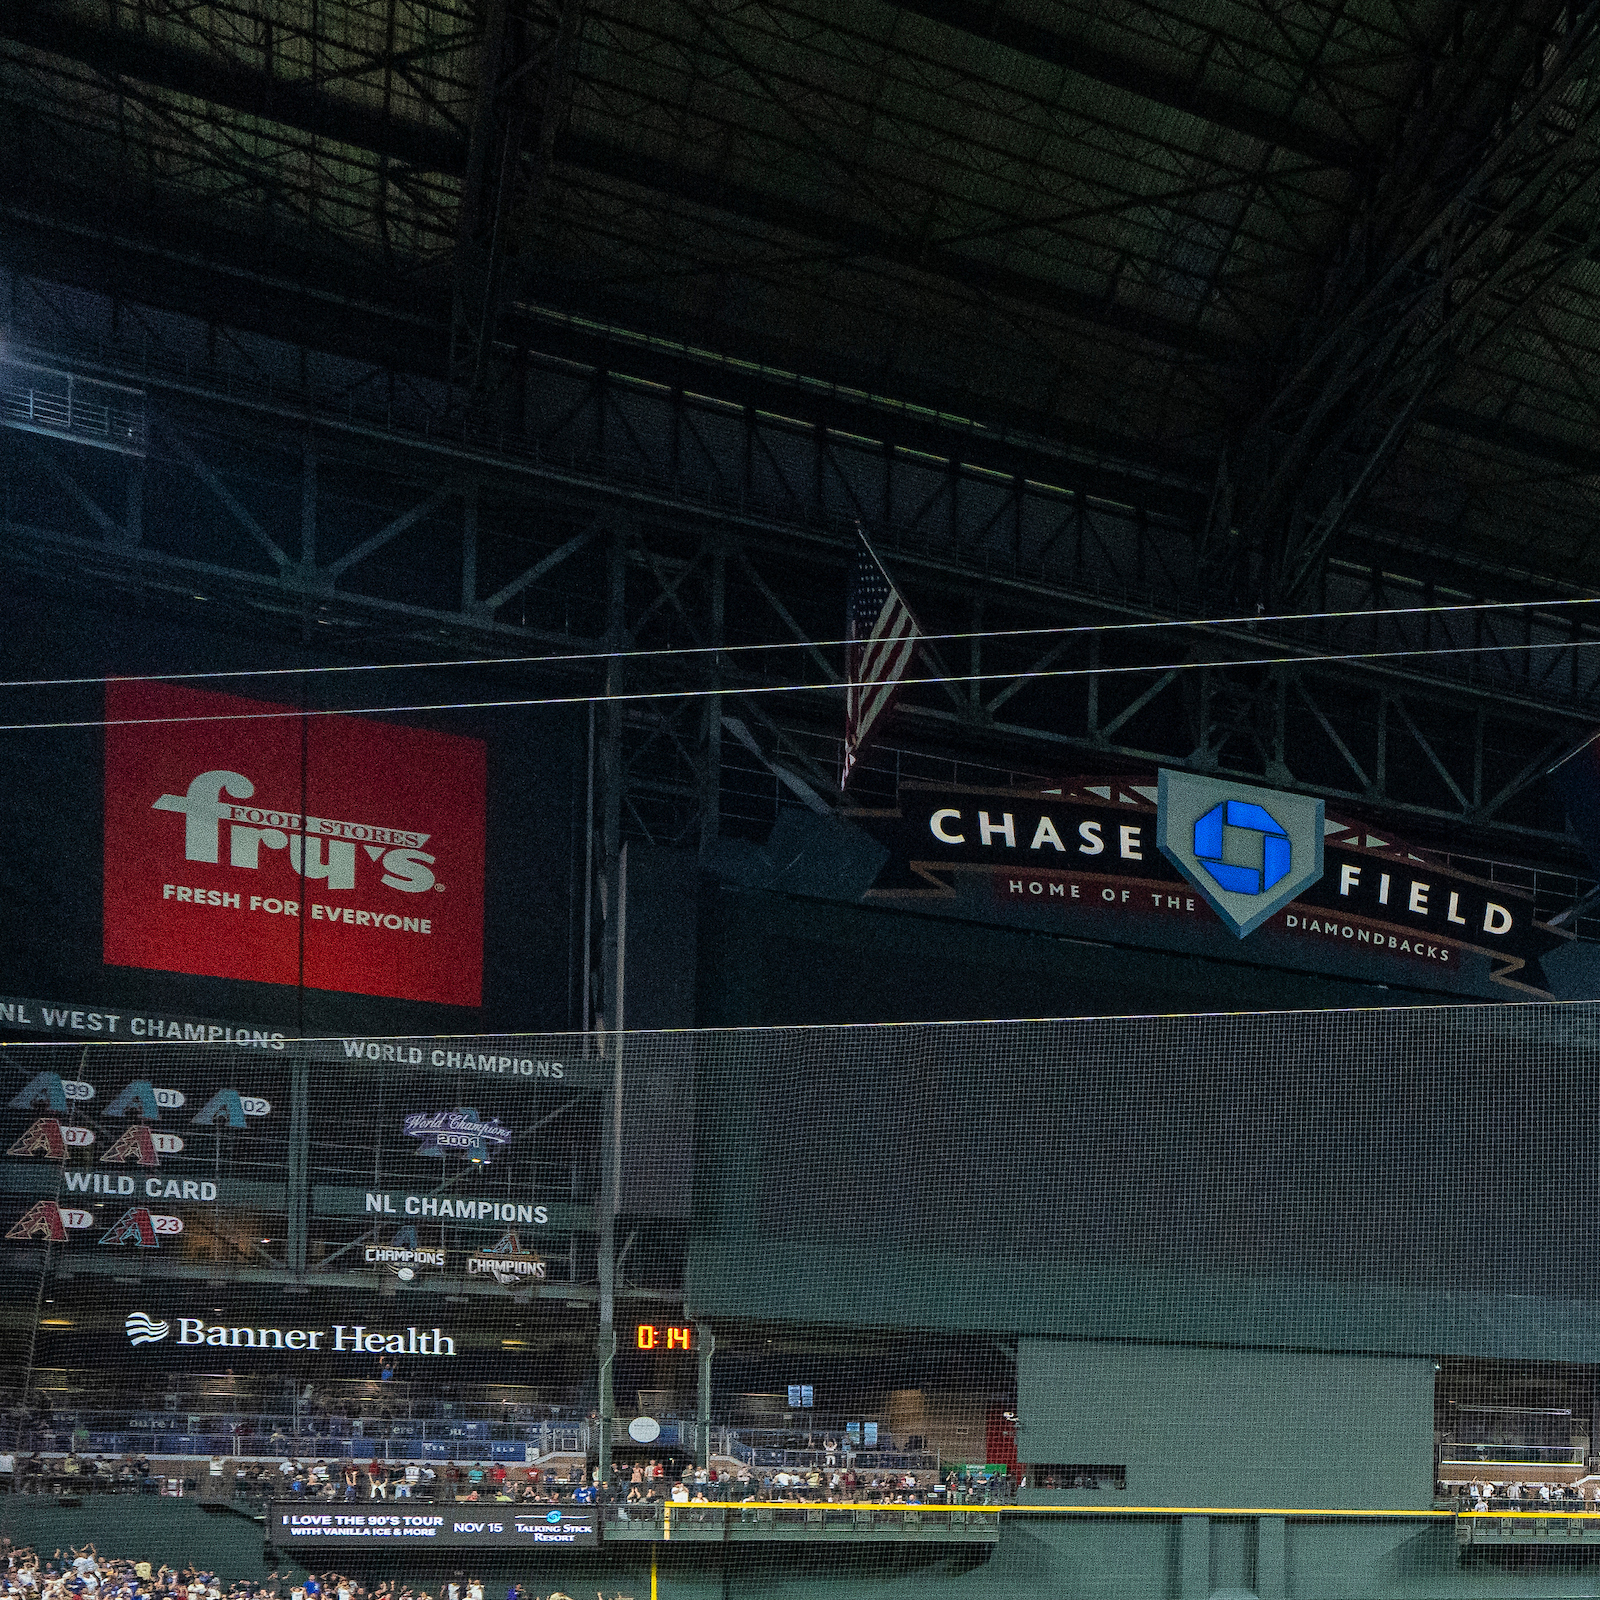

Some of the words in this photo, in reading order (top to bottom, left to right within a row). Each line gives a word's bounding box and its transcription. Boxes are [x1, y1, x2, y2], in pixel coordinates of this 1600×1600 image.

[152, 770, 435, 893] fry's
[229, 805, 307, 830] FOOD
[320, 820, 419, 848] STORES
[930, 807, 1143, 861] CHASE
[1339, 864, 1513, 935] FIELD
[163, 884, 240, 909] FRESH
[250, 895, 299, 917] FOR
[311, 904, 432, 934] EVERYONE
[1009, 879, 1081, 900] HOME
[1101, 887, 1132, 903] OF
[1152, 892, 1197, 912] THE
[1286, 913, 1452, 963] DIAMONDBACKS
[0, 1003, 31, 1024] NL
[42, 1008, 120, 1033] WEST
[131, 1017, 285, 1050] CHAMPIONS
[343, 1040, 422, 1064] WORLD
[432, 1050, 564, 1079] CHAMPIONS
[158, 1092, 178, 1105] 01
[244, 1101, 265, 1113] 02
[437, 1135, 480, 1148] 2001
[64, 1172, 135, 1195] WILD
[146, 1178, 217, 1201] CARD
[365, 1193, 396, 1214] NL
[405, 1197, 548, 1224] CHAMPIONS
[67, 1212, 84, 1226] 17
[157, 1218, 179, 1232] 23
[365, 1249, 445, 1266] CHAMPIONS
[468, 1259, 546, 1277] CHAMPIONS
[177, 1318, 327, 1352] Banner
[332, 1325, 456, 1357] Health
[637, 1325, 690, 1350] 0:14
[291, 1516, 332, 1526] LOVE
[335, 1516, 365, 1526] THE
[368, 1516, 400, 1526] 90'S
[402, 1516, 443, 1526] TOUR
[454, 1522, 486, 1534] NOV
[488, 1522, 503, 1534] 15
[515, 1524, 560, 1534] TALKING
[561, 1524, 592, 1534] STICK
[291, 1527, 321, 1536] WITH
[322, 1527, 370, 1536] VANILLA
[372, 1527, 391, 1536] ICE
[392, 1527, 402, 1536] &
[403, 1527, 436, 1536] MORE
[534, 1532, 574, 1542] RESORT
